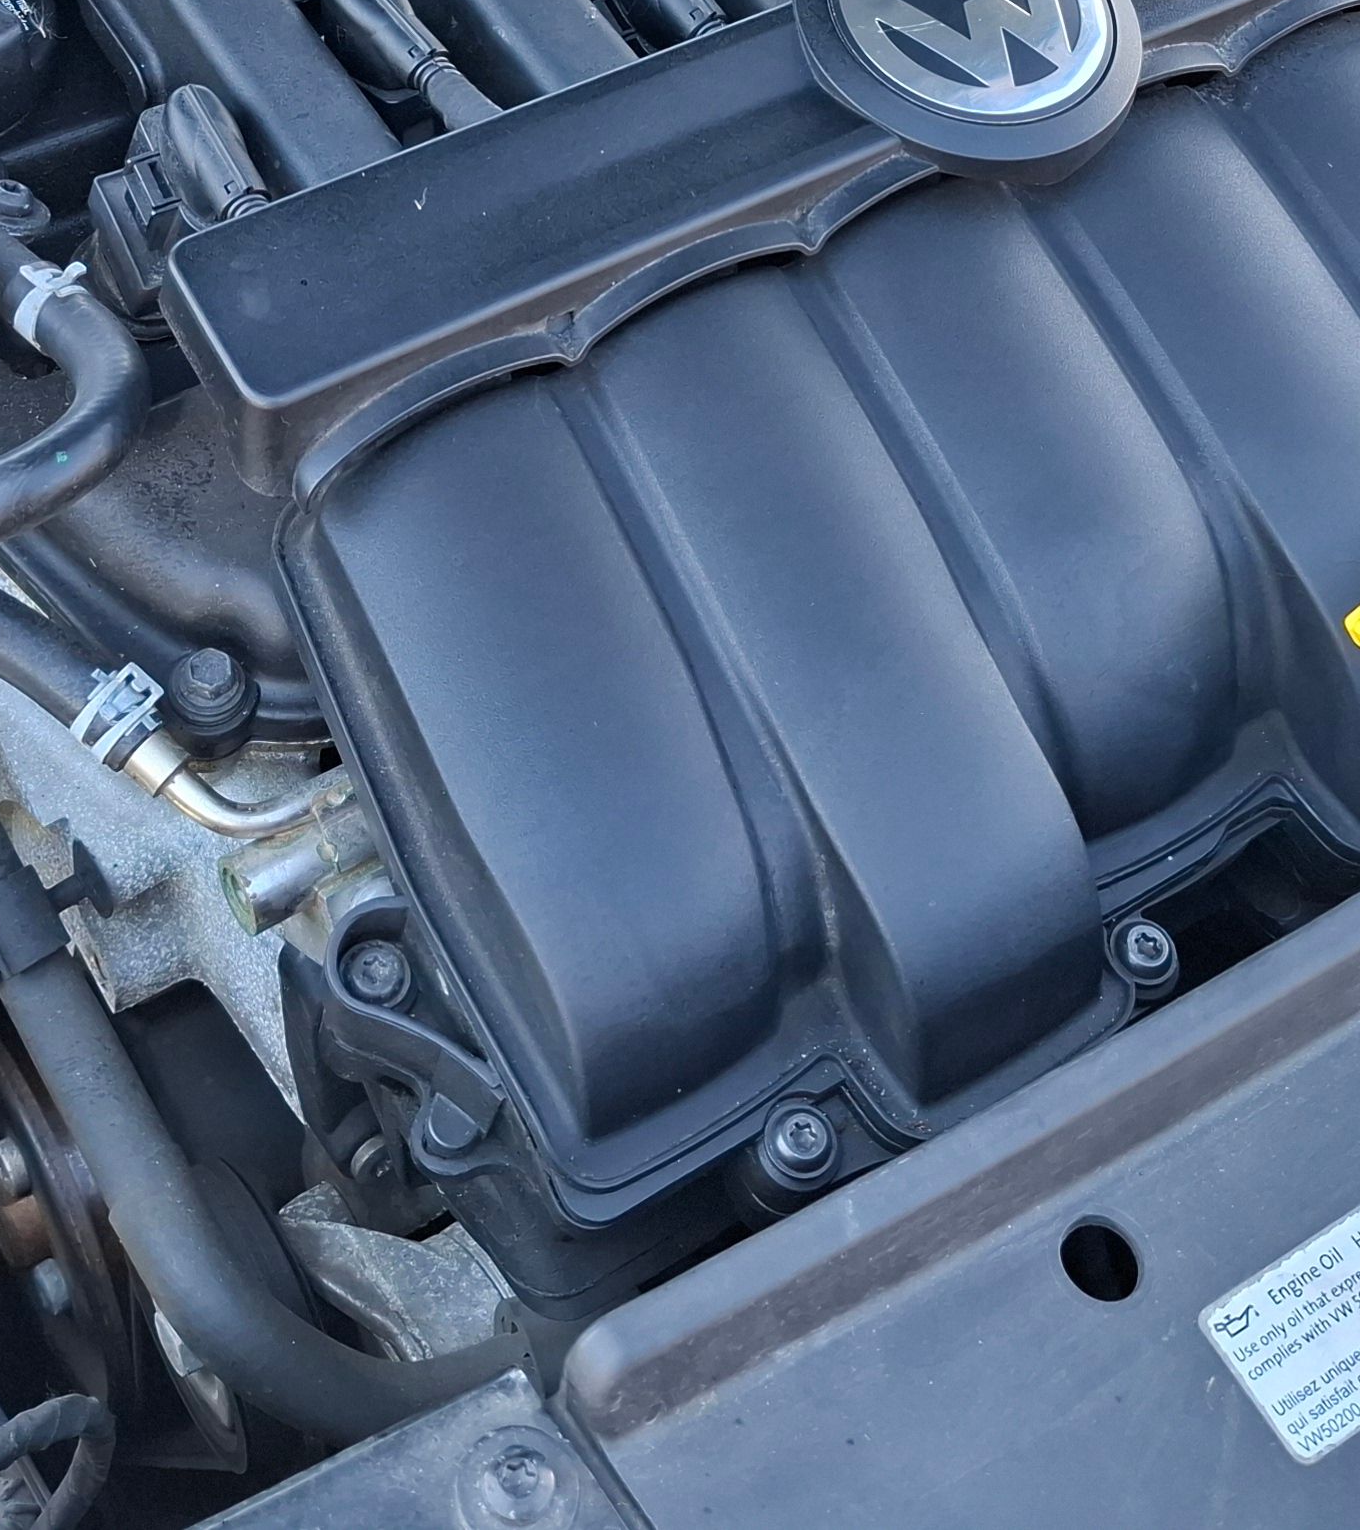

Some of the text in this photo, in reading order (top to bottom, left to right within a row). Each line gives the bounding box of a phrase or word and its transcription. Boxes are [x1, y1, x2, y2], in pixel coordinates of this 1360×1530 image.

[1267, 1266, 1321, 1304] Engine
[1319, 1246, 1343, 1269] Oil
[1232, 1342, 1259, 1362] Use
[1259, 1322, 1287, 1345] only
[1287, 1308, 1304, 1327] oil
[1302, 1291, 1331, 1315] that
[1248, 1338, 1302, 1380] complies
[1300, 1318, 1331, 1342] with
[1327, 1300, 1353, 1322] VW
[1271, 1379, 1321, 1415] Utilisez
[1287, 1415, 1308, 1435] qui
[1308, 1379, 1358, 1419] satisfait
